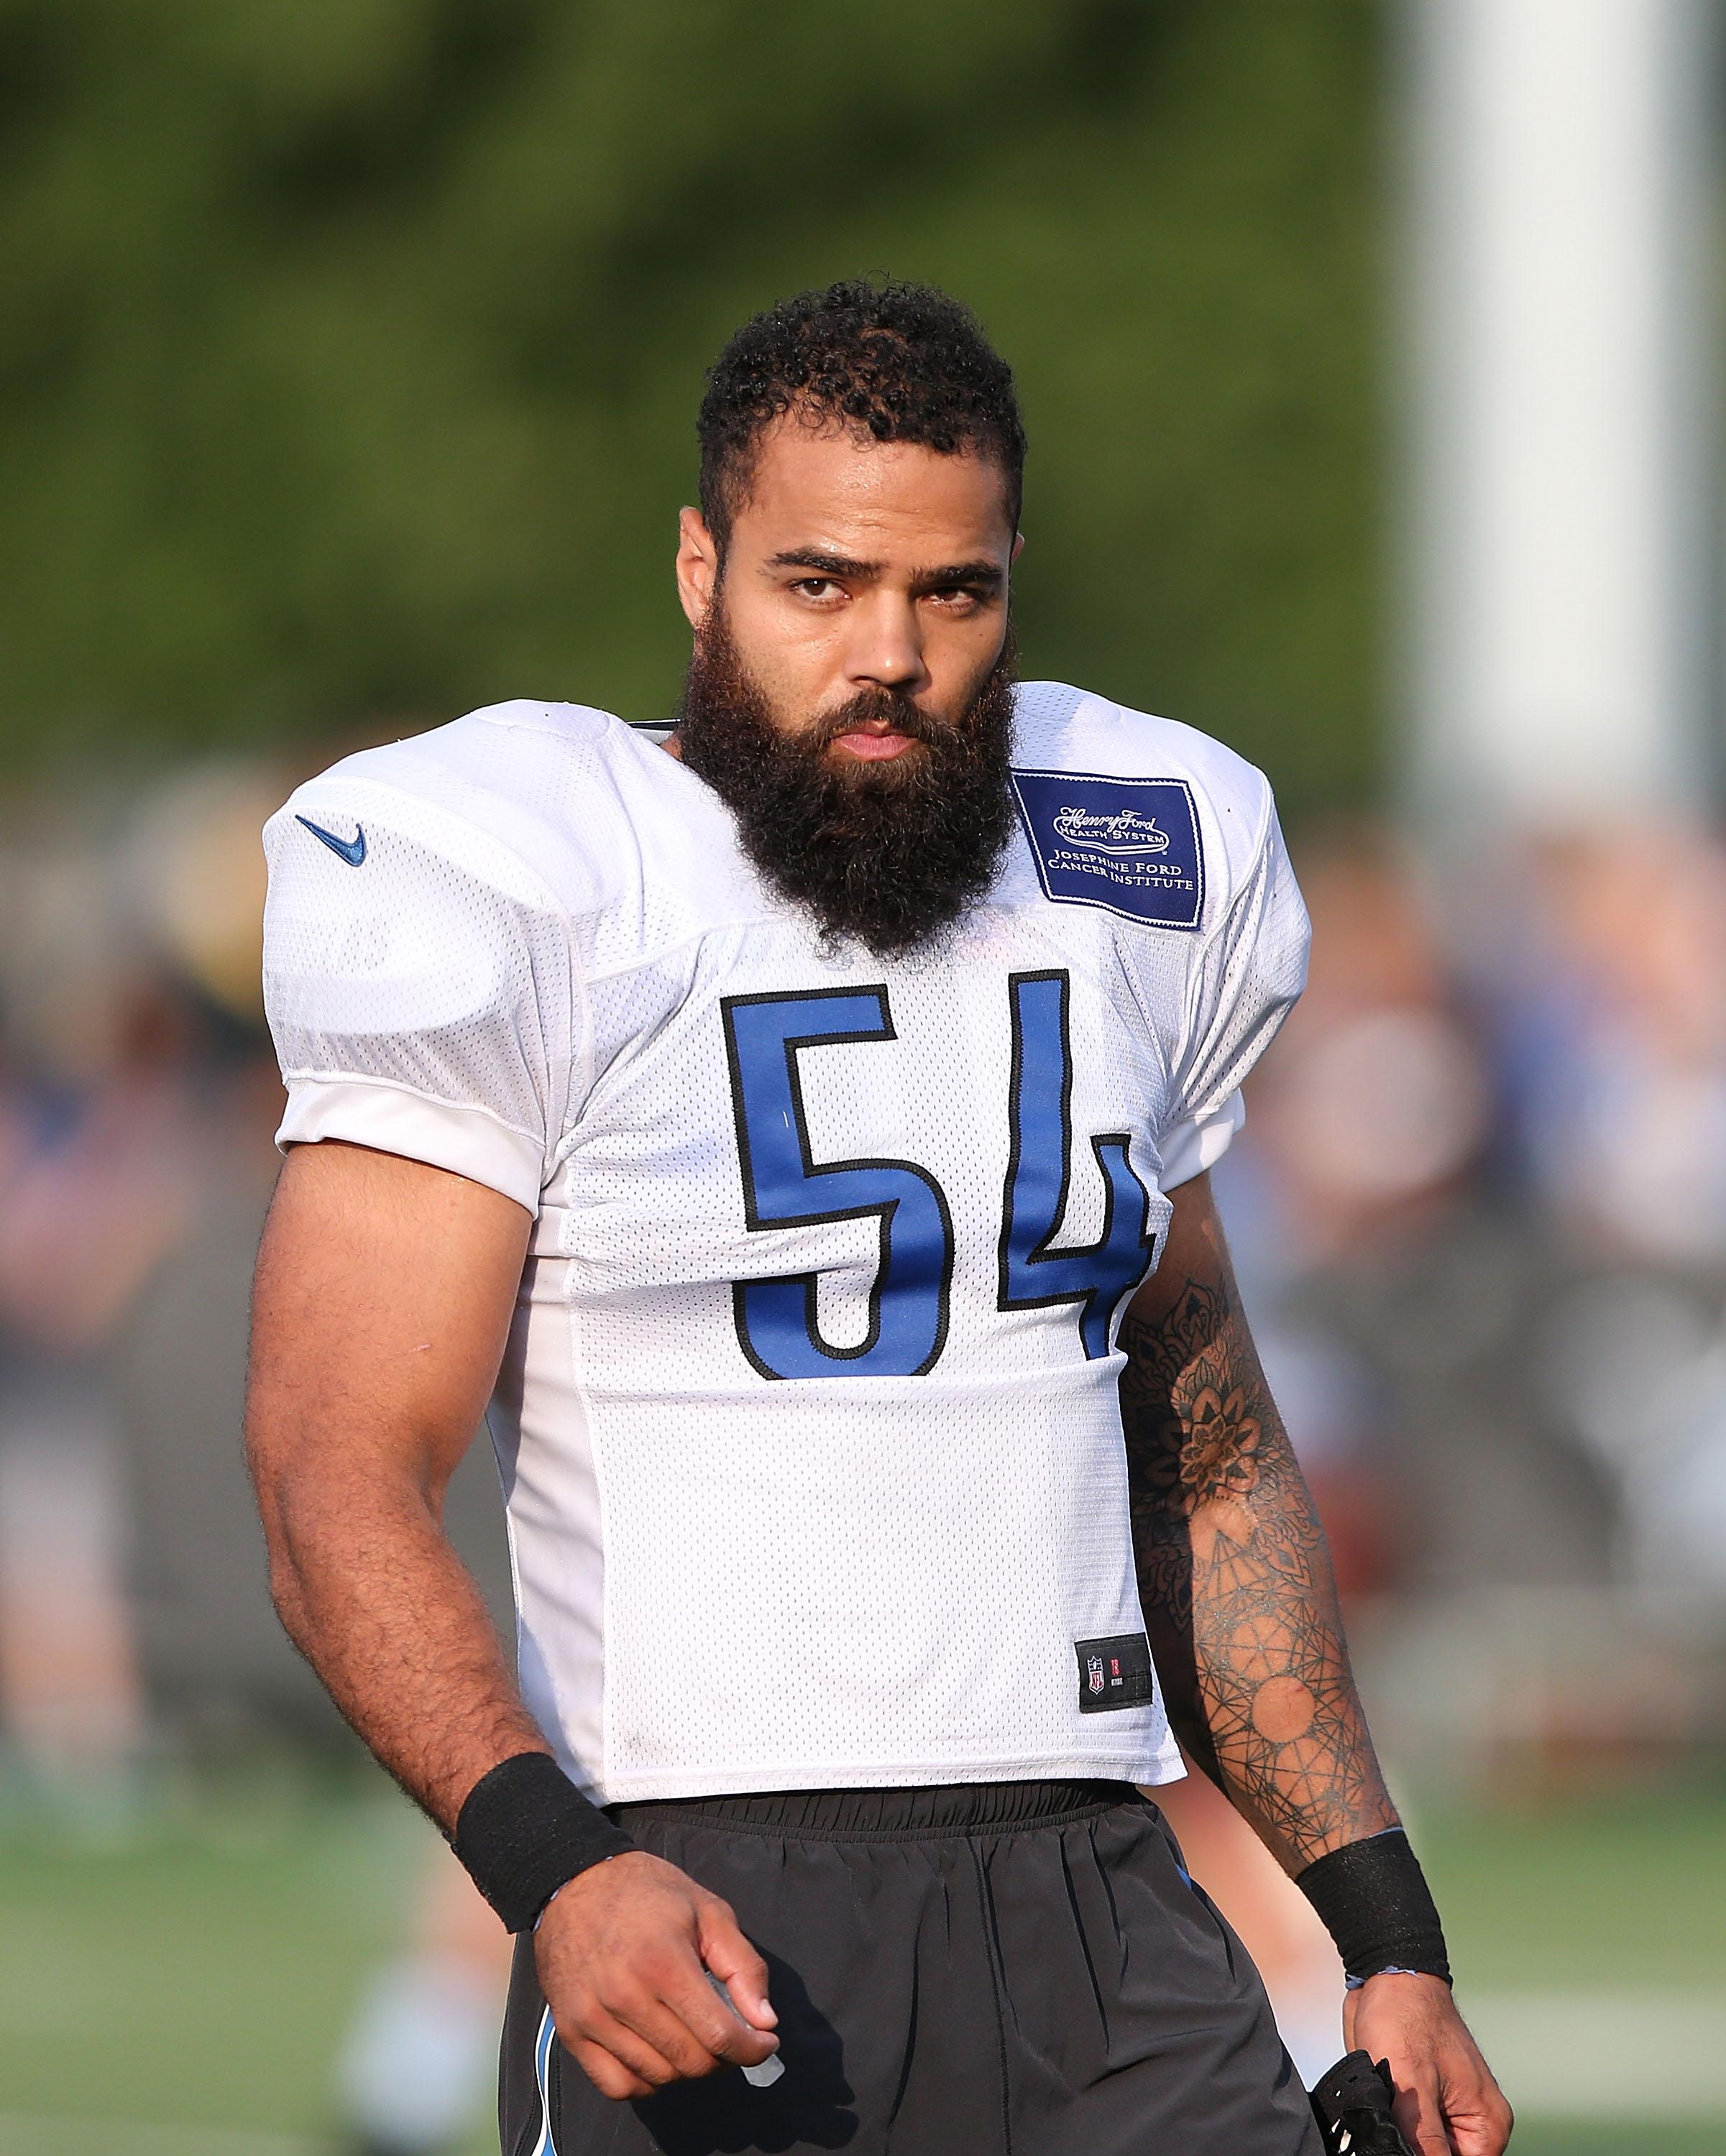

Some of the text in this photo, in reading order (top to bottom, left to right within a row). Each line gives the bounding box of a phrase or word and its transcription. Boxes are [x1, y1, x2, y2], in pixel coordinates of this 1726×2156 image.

[1060, 806, 1156, 833] Henry Ford
[1060, 825, 1165, 844] HEALTH SYSTEM
[1047, 859, 1194, 890] CANCER INSTITUTE
[1054, 849, 1183, 876] JOSEPHINE FORD
[720, 968, 1156, 1381] 54
